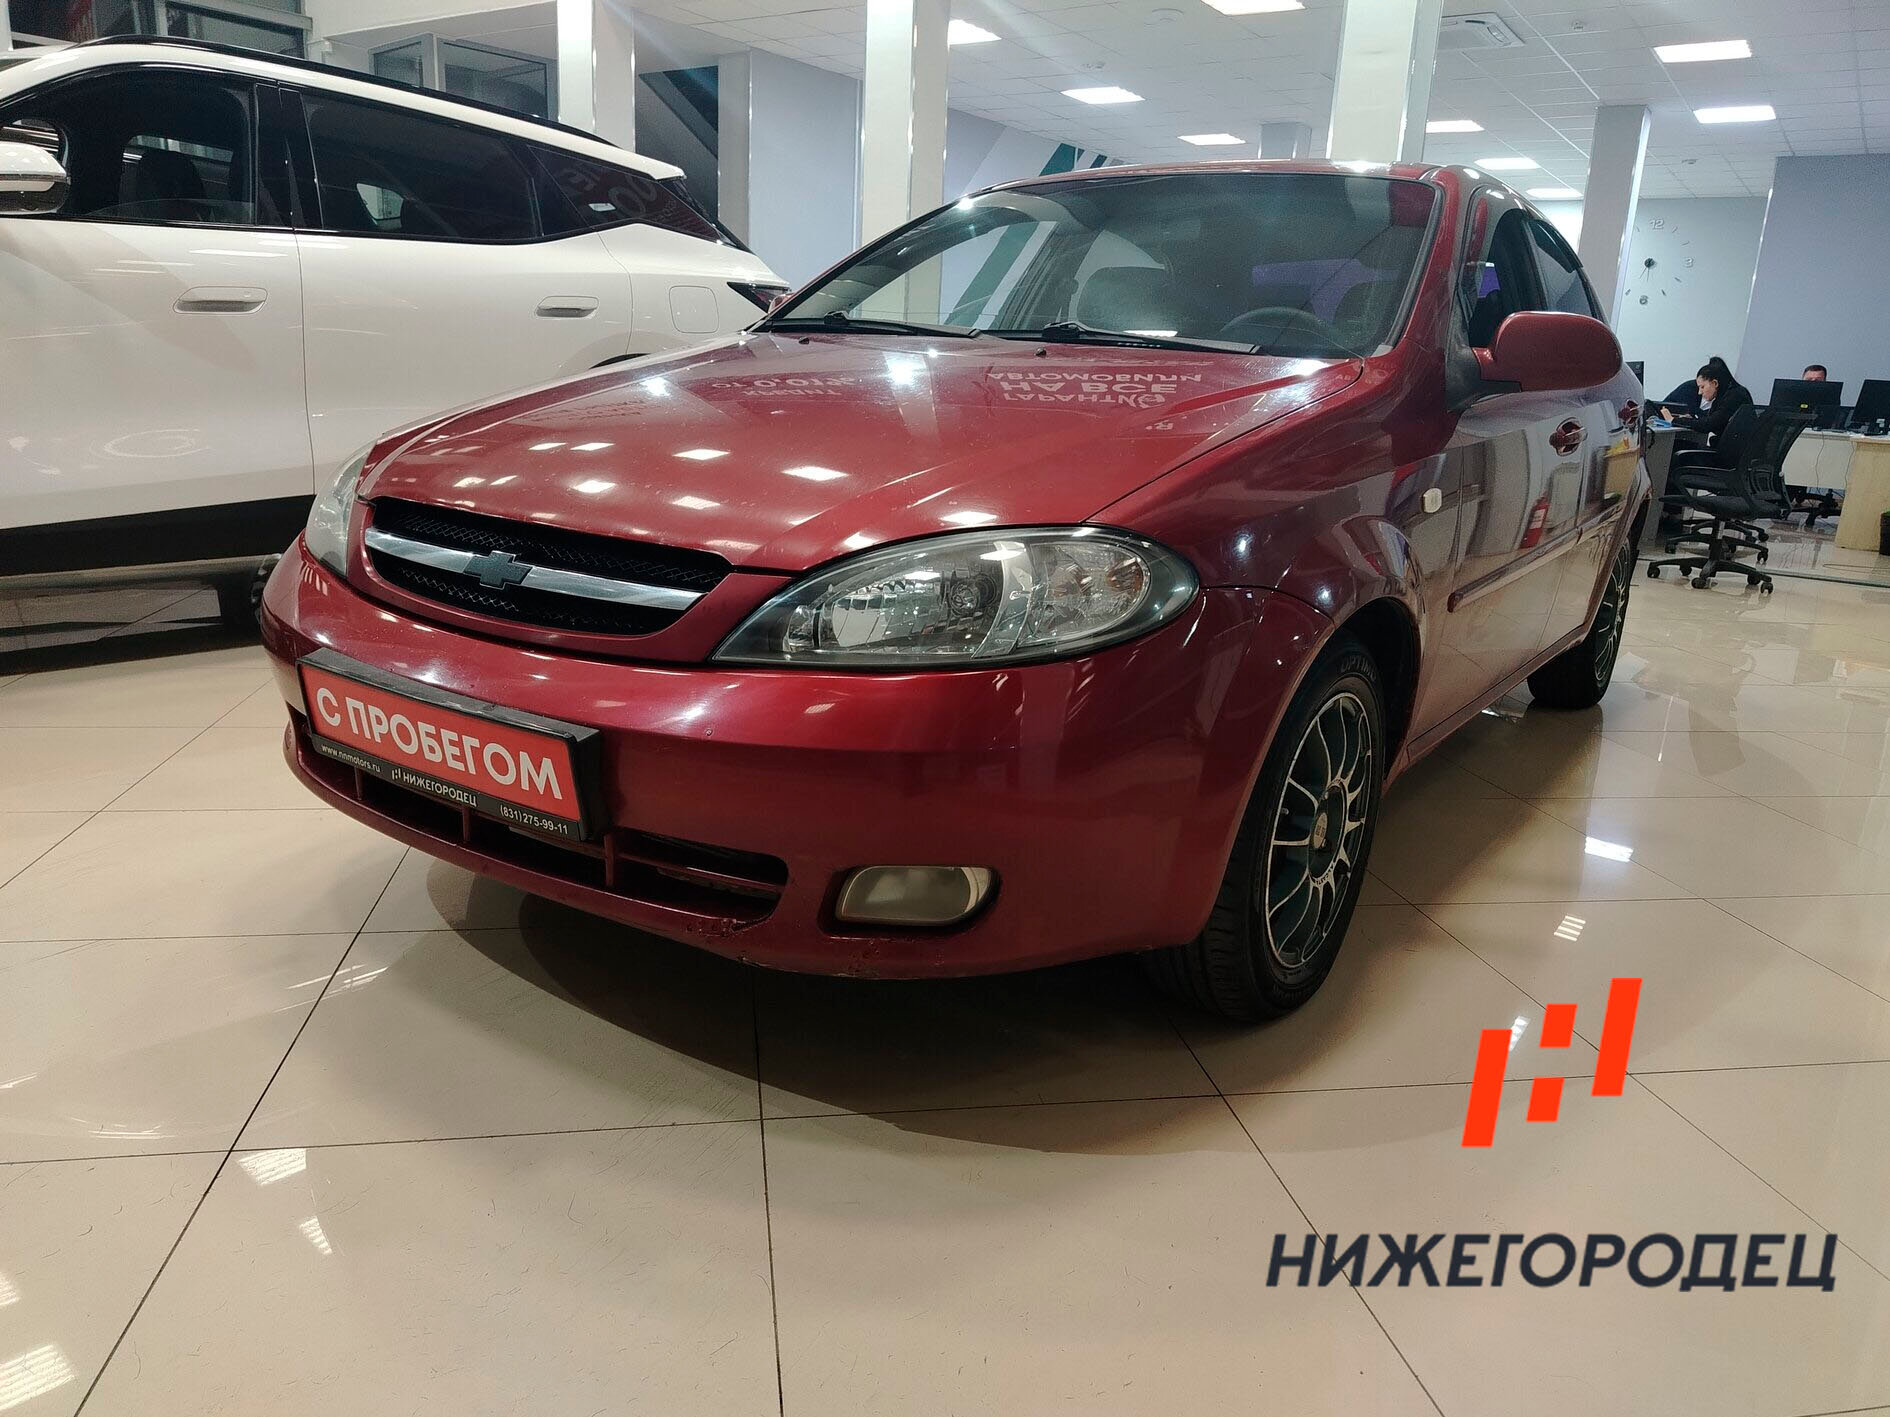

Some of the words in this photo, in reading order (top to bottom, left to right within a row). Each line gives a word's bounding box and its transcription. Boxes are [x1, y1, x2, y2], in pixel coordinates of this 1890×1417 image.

[1649, 219, 1664, 230] 12
[1685, 257, 1694, 269] 3
[316, 687, 341, 727] С
[345, 696, 563, 800] ПРОБЕГОМ
[321, 744, 381, 773] www.nnmotors.ru
[403, 772, 478, 808] НИЖЕГОРОДЕЦ
